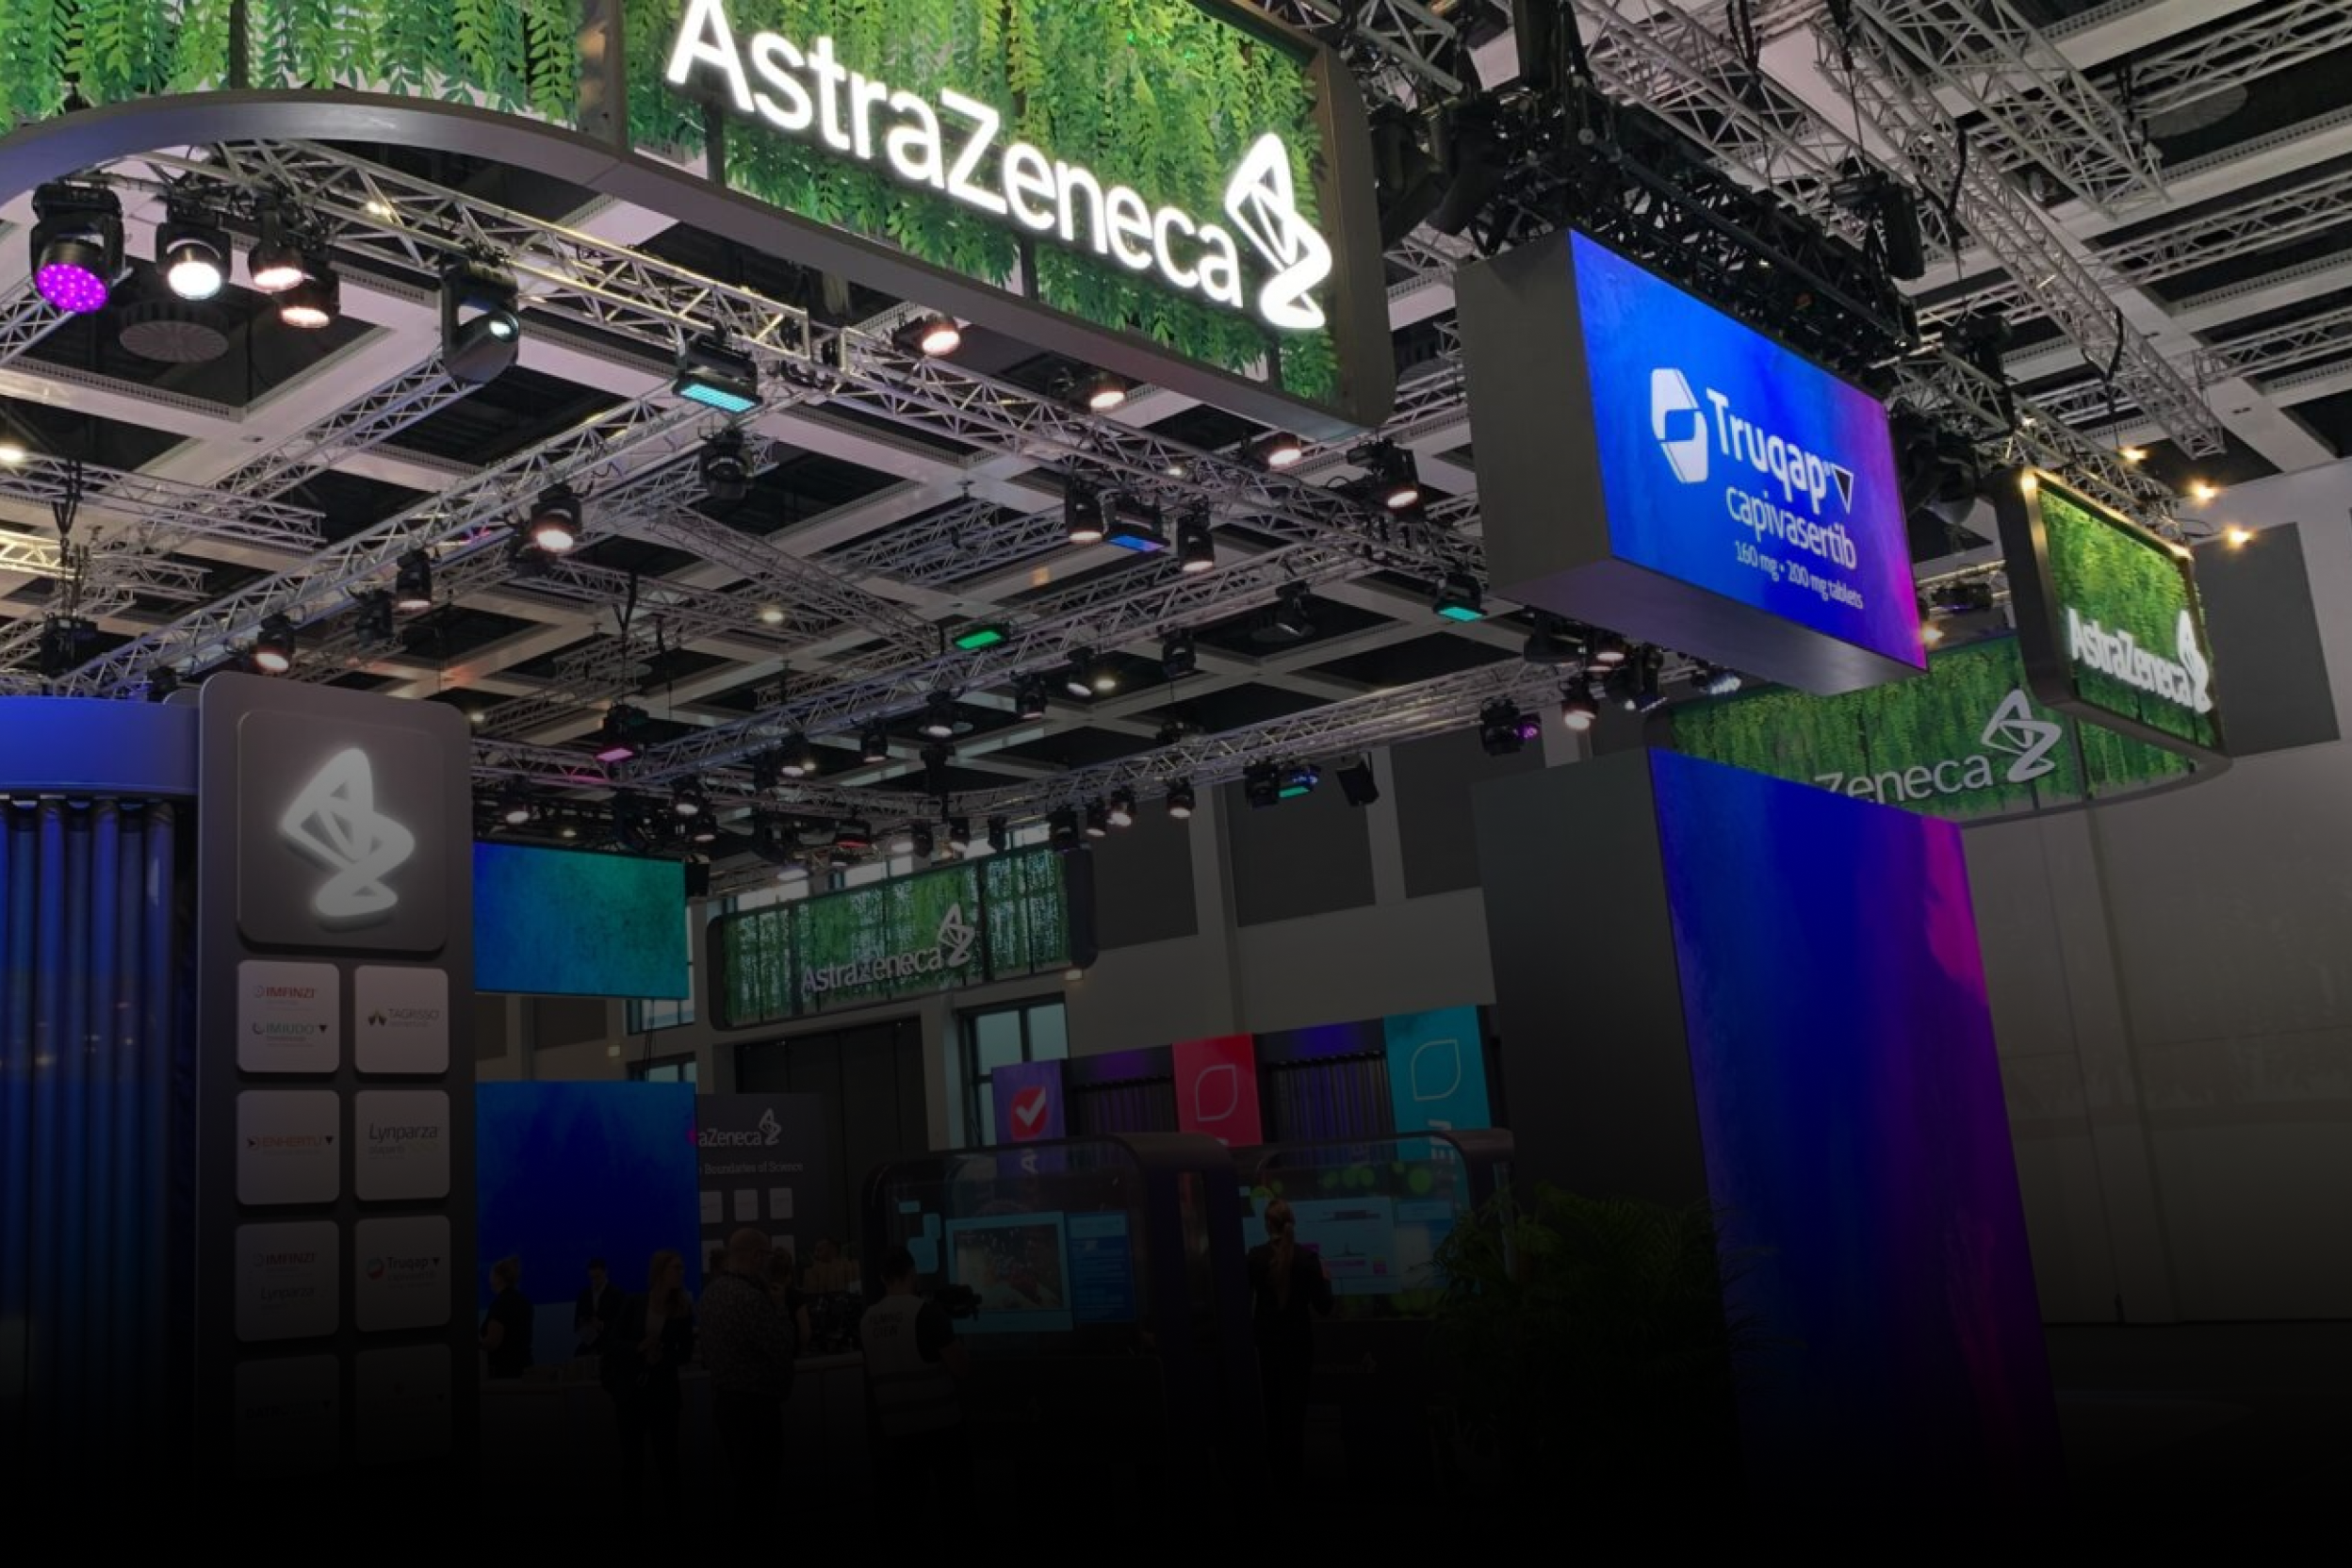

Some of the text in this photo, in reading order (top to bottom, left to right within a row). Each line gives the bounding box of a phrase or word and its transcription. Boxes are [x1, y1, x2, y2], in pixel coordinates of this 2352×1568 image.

[666, 0, 1244, 308] AstraZeneca
[1706, 386, 1828, 515] Truqap
[1725, 485, 1857, 570] capivasertib
[1735, 540, 1864, 610] 160 mg 200 mg tablets
[2066, 607, 2194, 709] AstraZeneca
[266, 986, 315, 999] IMFINZI
[801, 945, 943, 994] AstraZeneca
[368, 1122, 438, 1144] Lynparza
